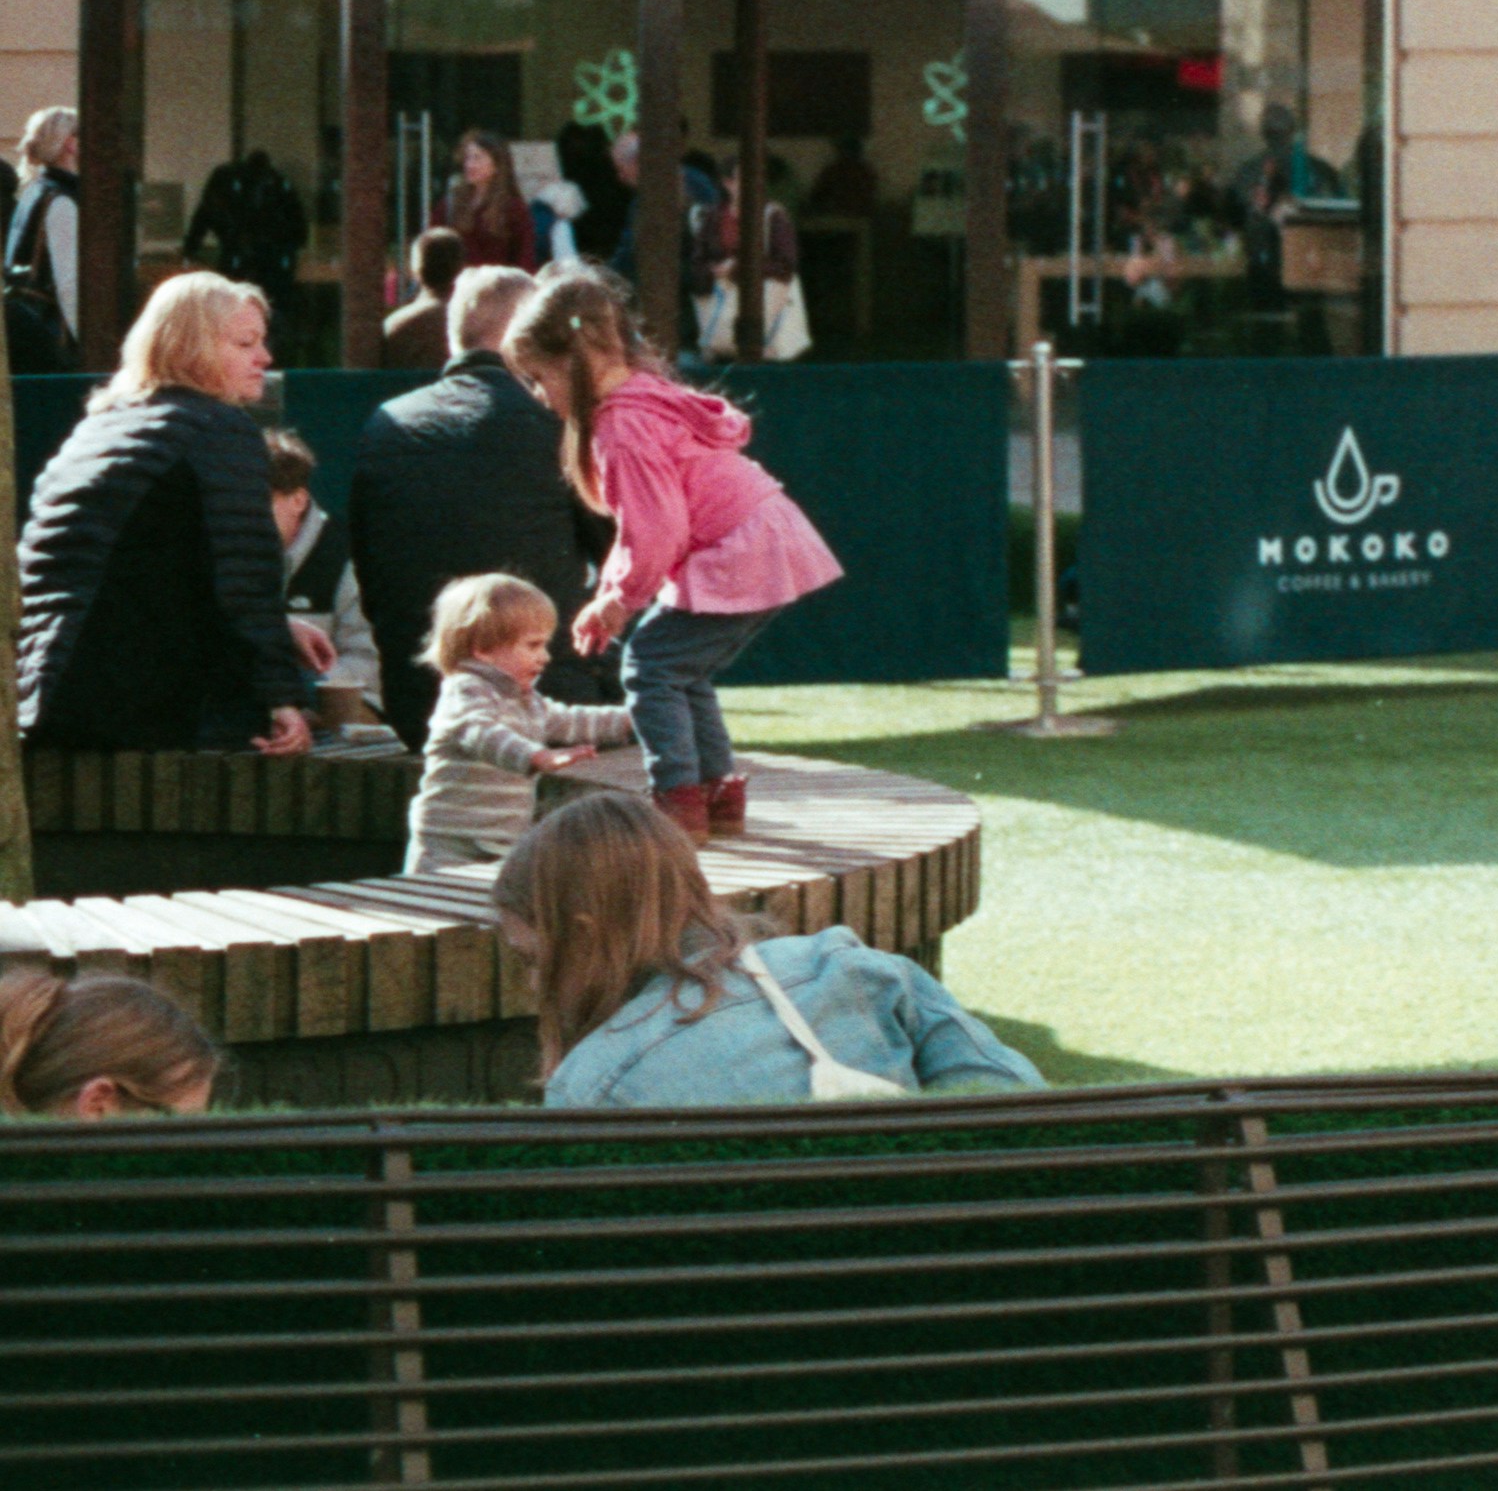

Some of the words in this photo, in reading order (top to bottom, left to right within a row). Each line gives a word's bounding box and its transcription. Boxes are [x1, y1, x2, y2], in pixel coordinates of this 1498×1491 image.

[1257, 530, 1451, 567] MOKOKO
[1277, 574, 1343, 594] COFFEE
[1349, 572, 1362, 590] &
[1367, 569, 1433, 589] BAKERY
